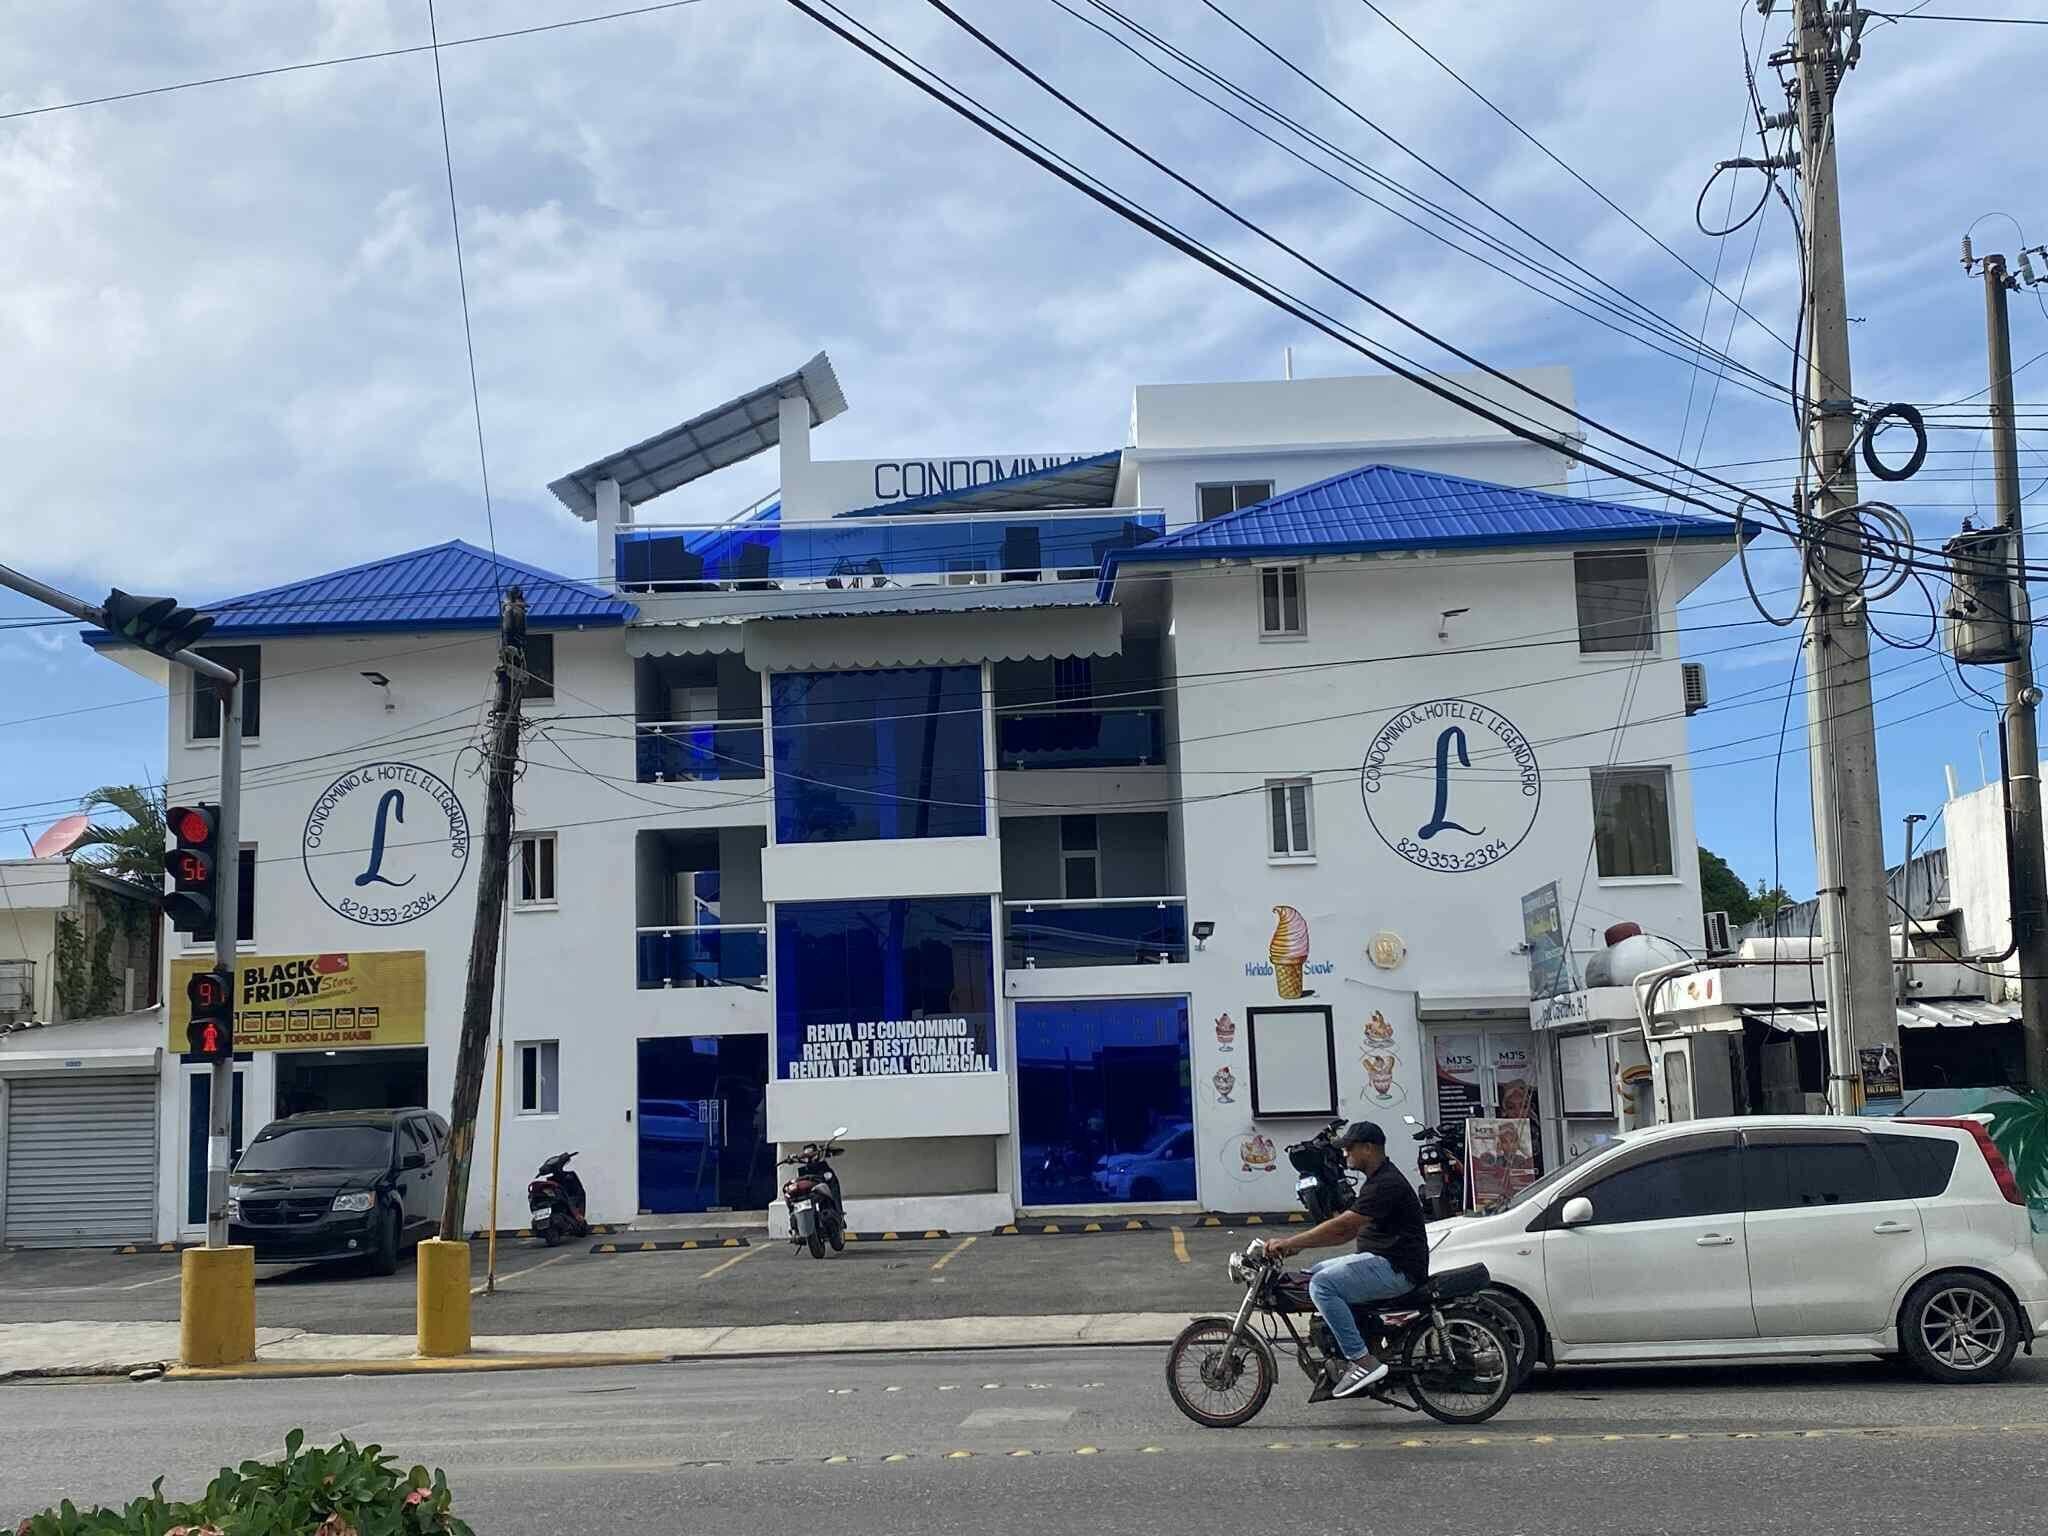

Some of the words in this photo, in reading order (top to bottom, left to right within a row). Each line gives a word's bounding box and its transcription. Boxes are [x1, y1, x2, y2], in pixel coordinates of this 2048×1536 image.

[874, 456, 1082, 499] CONDOM
[1366, 715, 1414, 793] CONDOMINIO
[1424, 703, 1466, 720] HOTEL
[1469, 707, 1485, 724] EL
[1487, 717, 1537, 796] LEGENDARIO
[307, 775, 360, 849] CONDOMINIO
[378, 766, 418, 785] HOTEL
[418, 775, 431, 793] EL
[431, 785, 467, 859] LEGENDARIO
[244, 959, 315, 986] BLACK
[243, 976, 323, 1005] FRIDAY
[284, 1032, 318, 1043] TODOS
[320, 1031, 340, 1042] LOS
[807, 1023, 853, 1042] RENTA
[857, 1022, 875, 1040] DE
[877, 1018, 967, 1039] CONDOMINIO
[803, 1042, 850, 1061] RENTA
[852, 1041, 869, 1058] DE
[873, 1037, 975, 1058] RESTAURANTE
[789, 1061, 836, 1079] RENTA
[839, 1060, 857, 1077] DE
[862, 1057, 907, 1076] LOCAL
[911, 1053, 992, 1075] COMERCIAL
